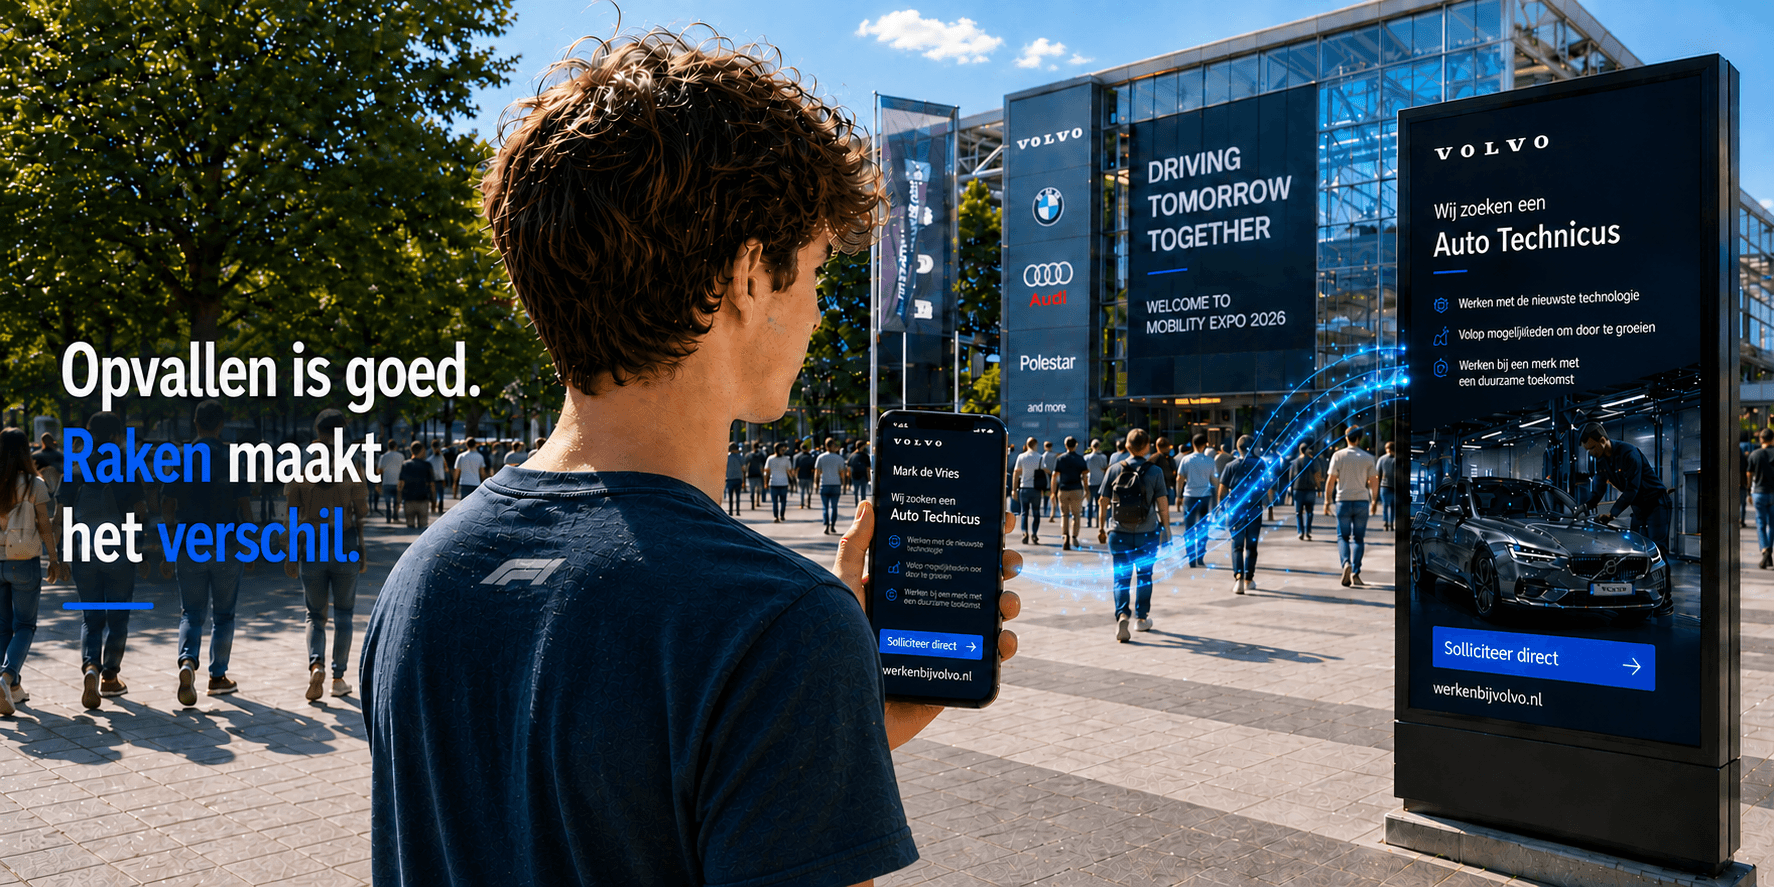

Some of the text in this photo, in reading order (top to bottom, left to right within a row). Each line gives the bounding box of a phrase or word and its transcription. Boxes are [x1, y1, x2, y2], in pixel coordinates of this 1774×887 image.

[1017, 127, 1083, 149] VOLVO
[1434, 135, 1549, 160] VOLVO
[1148, 146, 1241, 183] DRIVING
[1148, 175, 1292, 217] TOMORROW
[1434, 197, 1546, 221] Wij zoeken een
[1148, 216, 1271, 252] TOGETHER
[1433, 220, 1620, 257] Auto Technicus
[1029, 290, 1067, 307] Audi
[1147, 294, 1231, 314] WELCOME TO
[1458, 290, 1640, 309] Werken met de nieuwste technologie
[1147, 310, 1286, 334] MOBILITY EXPO 2026
[1458, 329, 1484, 341] Volop
[1556, 327, 1573, 336] om
[1576, 324, 1600, 336] door
[1602, 324, 1614, 334] te
[1616, 322, 1656, 337] groeien
[1020, 354, 1076, 371] Polestar
[1459, 357, 1580, 372] Werken bij een merk met
[1459, 374, 1574, 386] een duurzame toekomst
[1027, 402, 1066, 412] and more
[894, 438, 942, 447] VOLVO
[893, 466, 960, 478] Mark de Vries
[891, 492, 904, 504] Wij
[938, 497, 956, 506] een
[890, 508, 980, 525] Auto Technicus
[888, 636, 957, 650] Solliciteer direct
[1444, 641, 1559, 666] Solliciteer direct
[882, 666, 972, 681] werkenbijvolvo.nl
[1433, 682, 1543, 706] werkenbijvolvo.nl
